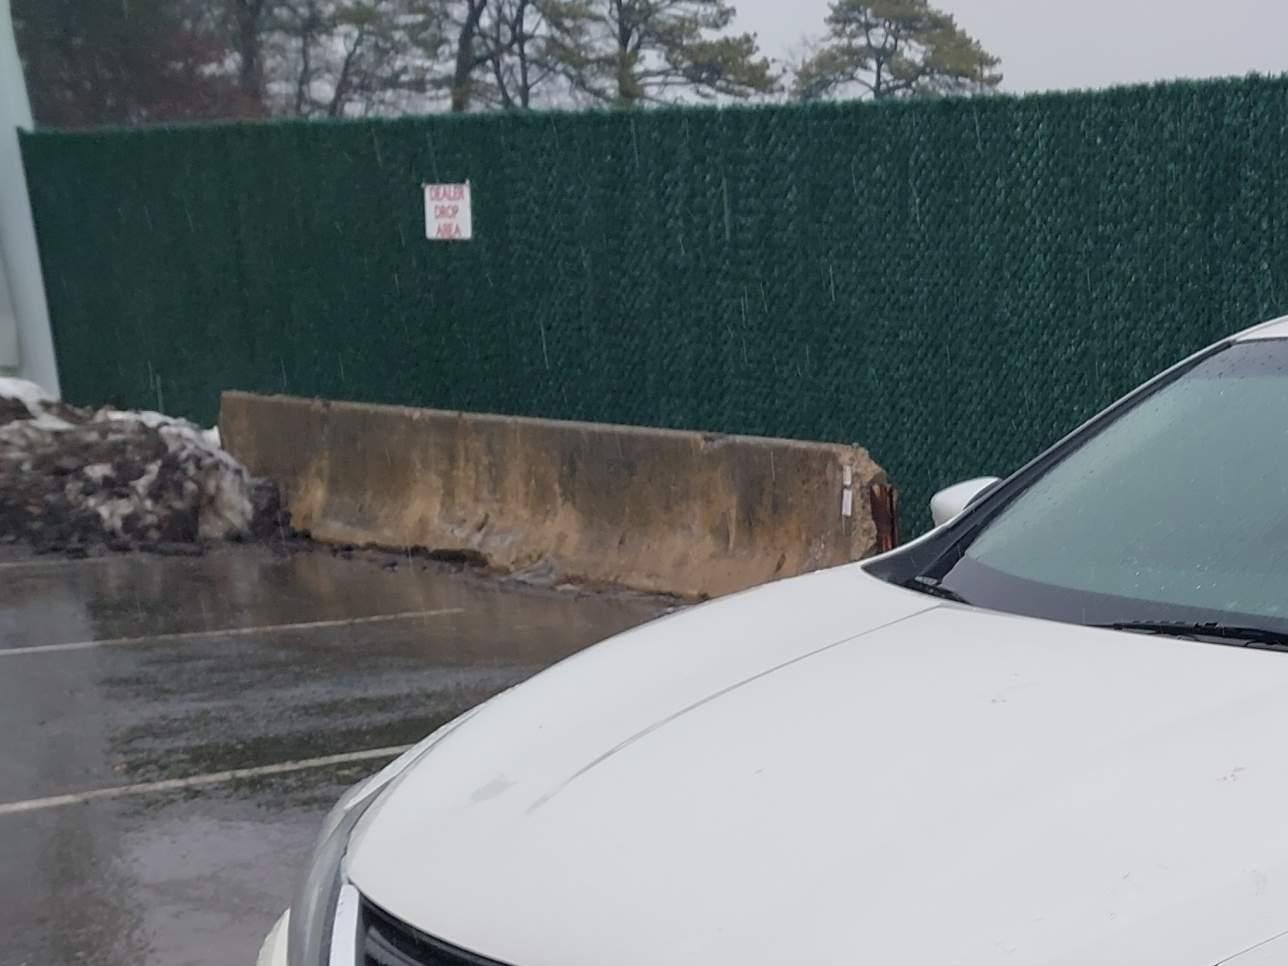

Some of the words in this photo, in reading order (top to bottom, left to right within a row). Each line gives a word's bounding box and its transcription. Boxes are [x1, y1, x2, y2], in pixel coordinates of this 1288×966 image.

[430, 186, 465, 200] DEALER
[434, 204, 459, 218] DROP
[436, 223, 462, 238] AREA
